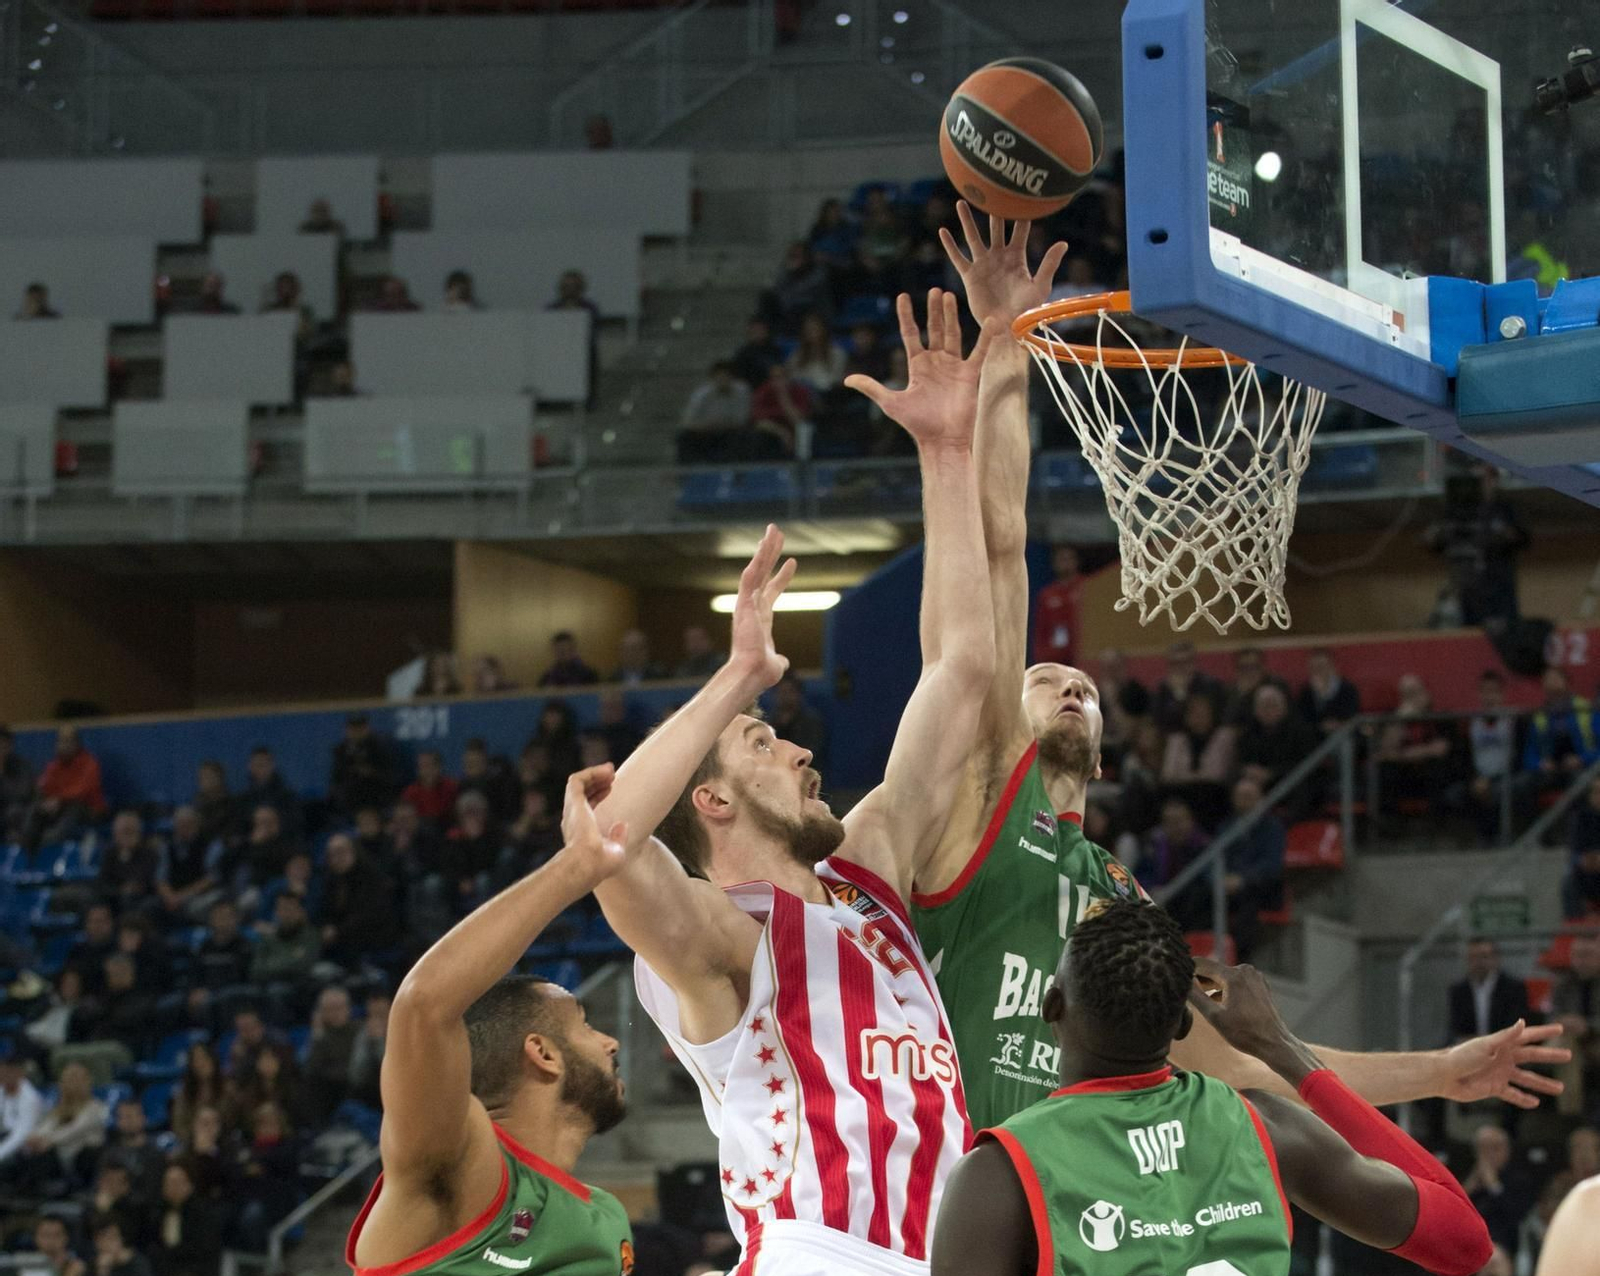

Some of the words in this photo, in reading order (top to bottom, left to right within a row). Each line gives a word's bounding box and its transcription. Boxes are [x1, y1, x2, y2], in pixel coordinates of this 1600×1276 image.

[950, 109, 1049, 197] SPALDING
[1218, 172, 1250, 209] team
[1126, 1119, 1185, 1175] DIOP
[1130, 1219, 1171, 1239] Save
[1170, 1218, 1195, 1238] the
[1194, 1200, 1263, 1227] Children
